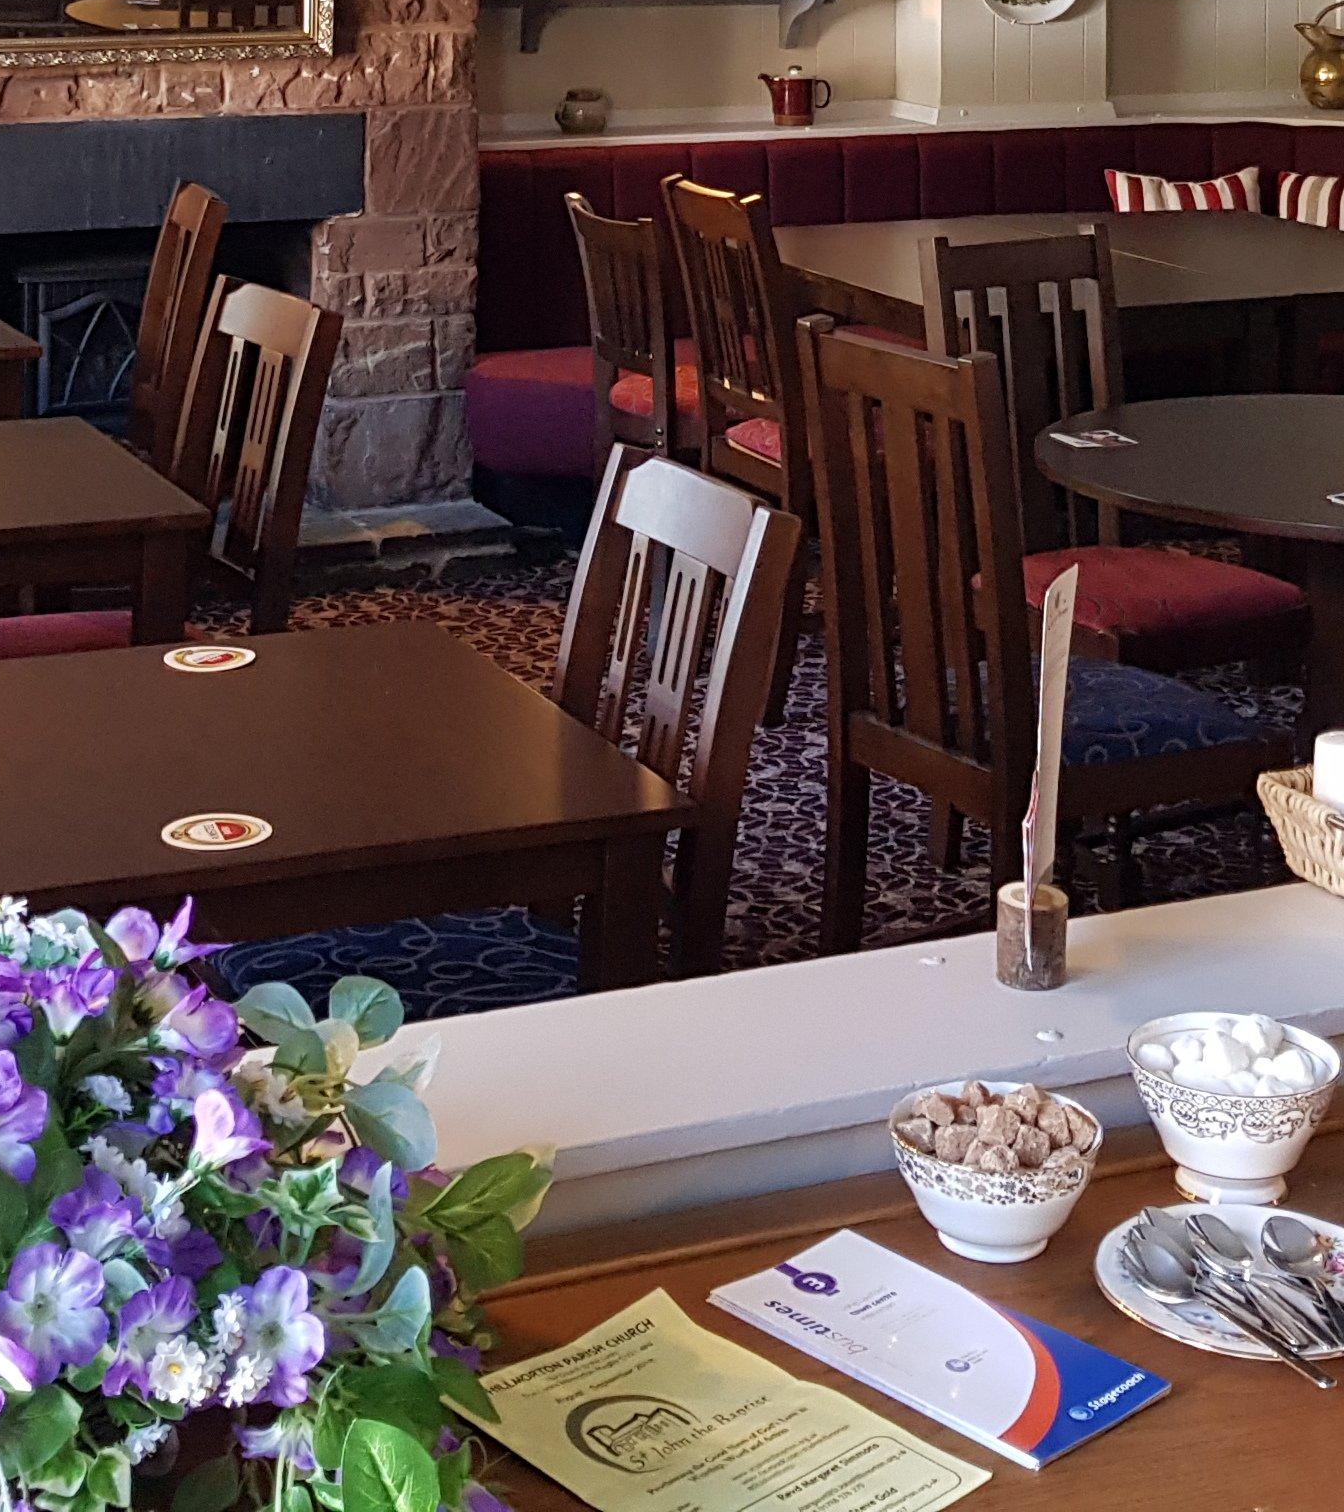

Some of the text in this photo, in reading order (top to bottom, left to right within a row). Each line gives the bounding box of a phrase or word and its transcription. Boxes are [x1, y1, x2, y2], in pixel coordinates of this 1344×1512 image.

[562, 1343, 606, 1367] PARISH
[605, 1317, 656, 1349] CHURCH
[1087, 1371, 1146, 1411] Stagecoach
[651, 1436, 692, 1460] John
[691, 1424, 717, 1440] the
